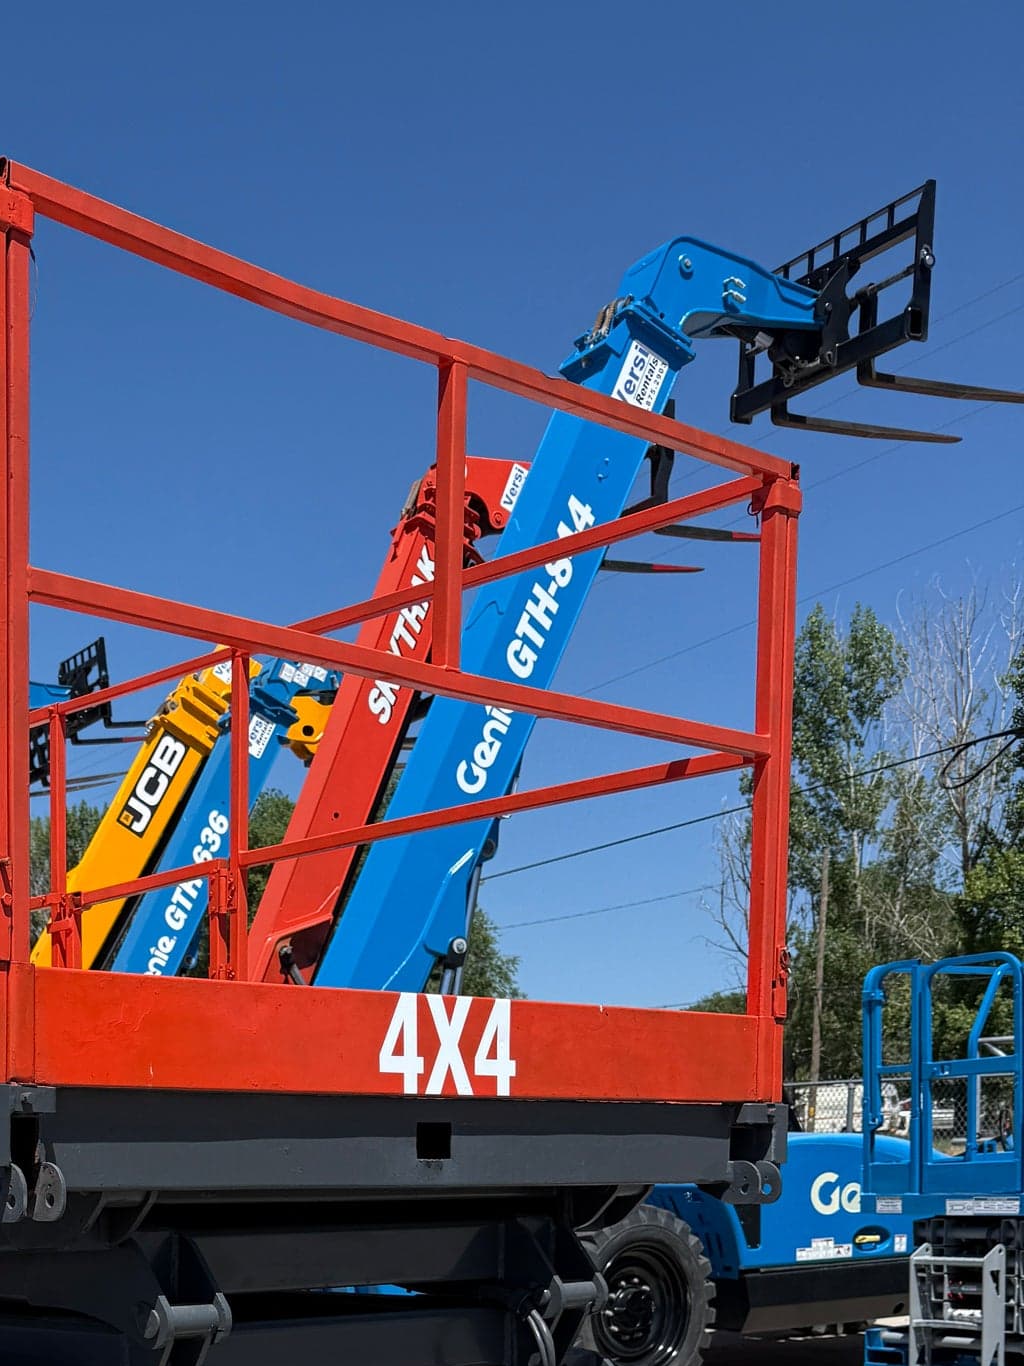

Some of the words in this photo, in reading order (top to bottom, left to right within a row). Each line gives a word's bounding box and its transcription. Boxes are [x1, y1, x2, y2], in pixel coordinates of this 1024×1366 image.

[635, 358, 659, 406] Rentals
[503, 466, 525, 505] Versi
[127, 735, 186, 833] JCB
[456, 704, 515, 794] Geni
[144, 936, 177, 976] nie
[164, 809, 229, 931] GTH636
[378, 992, 517, 1097] 4X4
